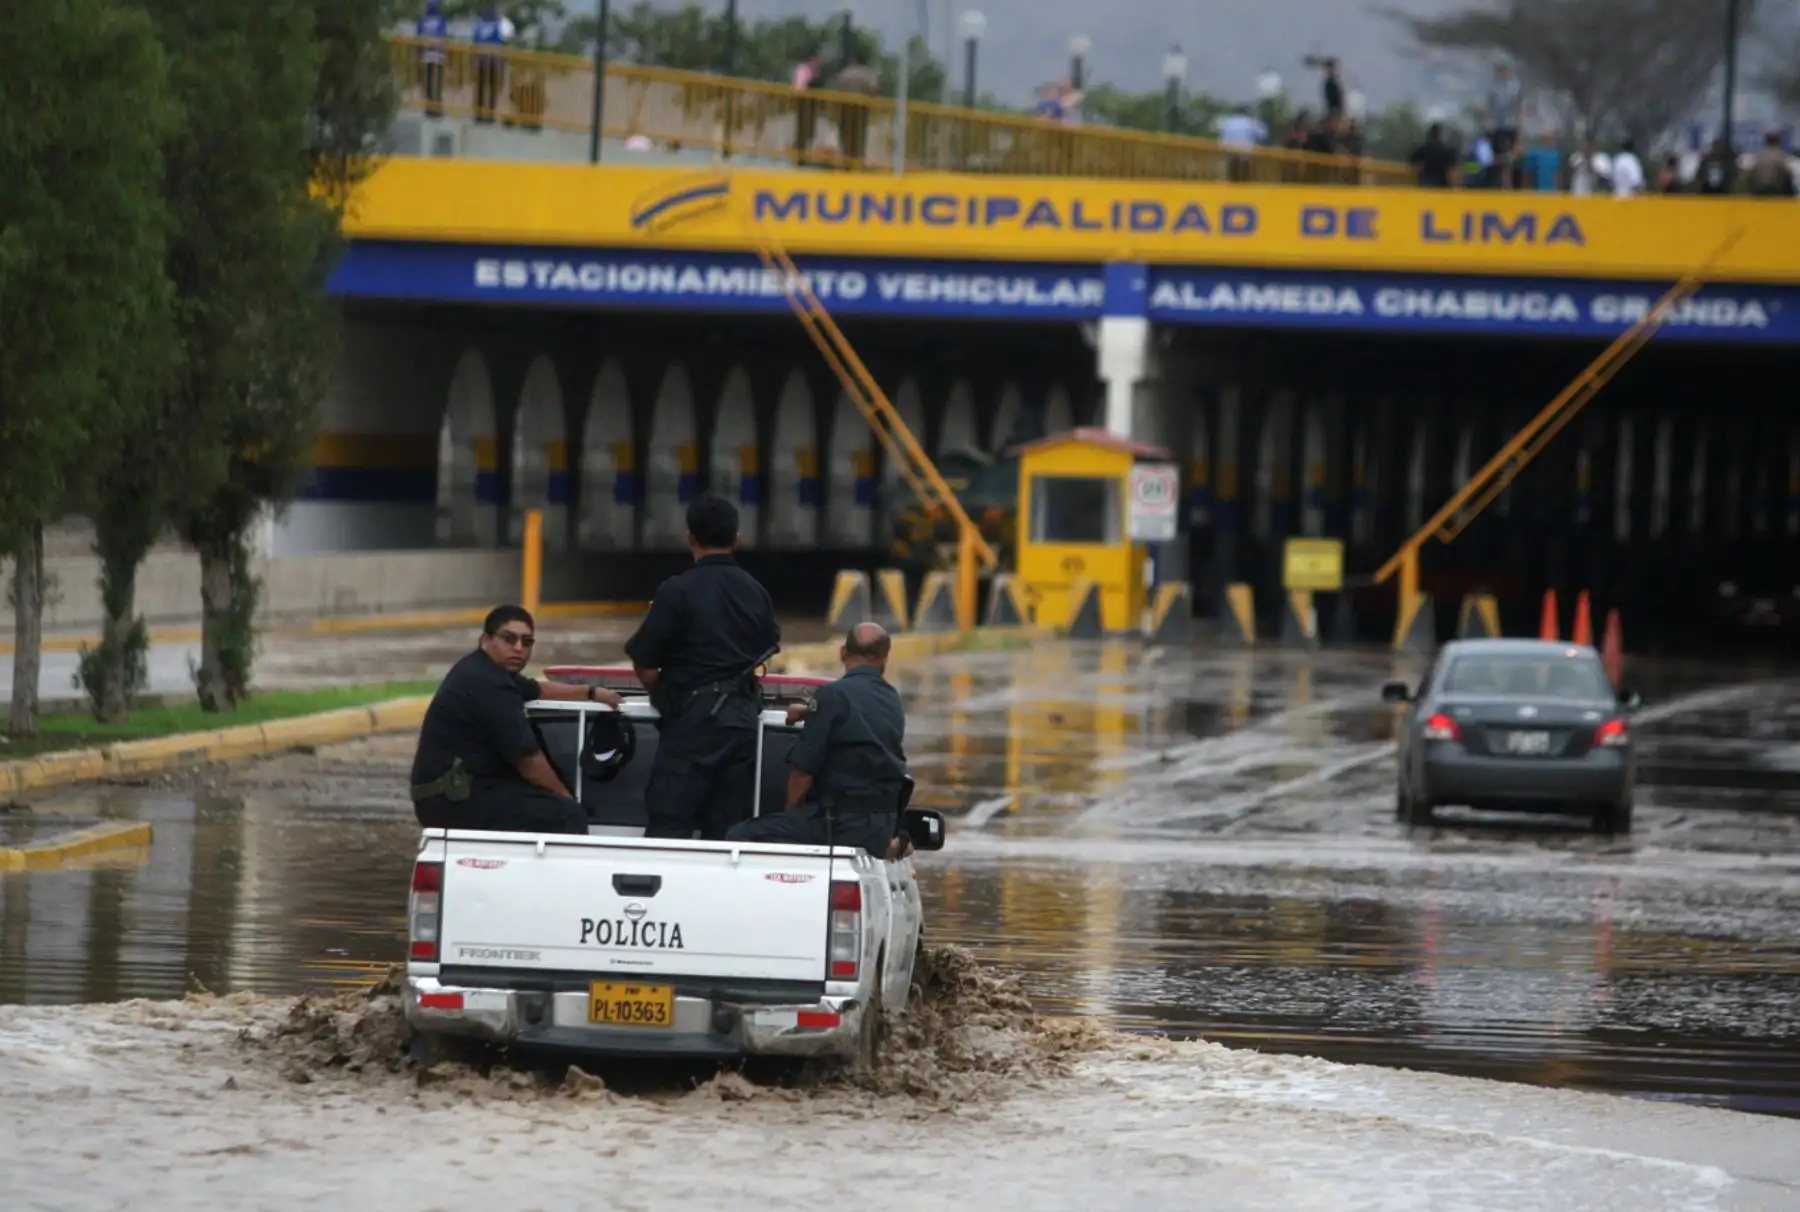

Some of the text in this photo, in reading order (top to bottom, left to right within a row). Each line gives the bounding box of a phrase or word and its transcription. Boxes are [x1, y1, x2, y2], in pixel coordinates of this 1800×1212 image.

[754, 189, 1586, 246] MUNICIPALIDAD DE LIMA
[474, 258, 1105, 306] ESTACIONAMIENTO VEHICULAR
[1151, 281, 1364, 316] ALAMEDA
[1373, 288, 1578, 322] CHABUCA
[580, 917, 684, 949] POLICIA
[459, 947, 541, 961] FRONTIER
[594, 998, 666, 1022] PL-10363
